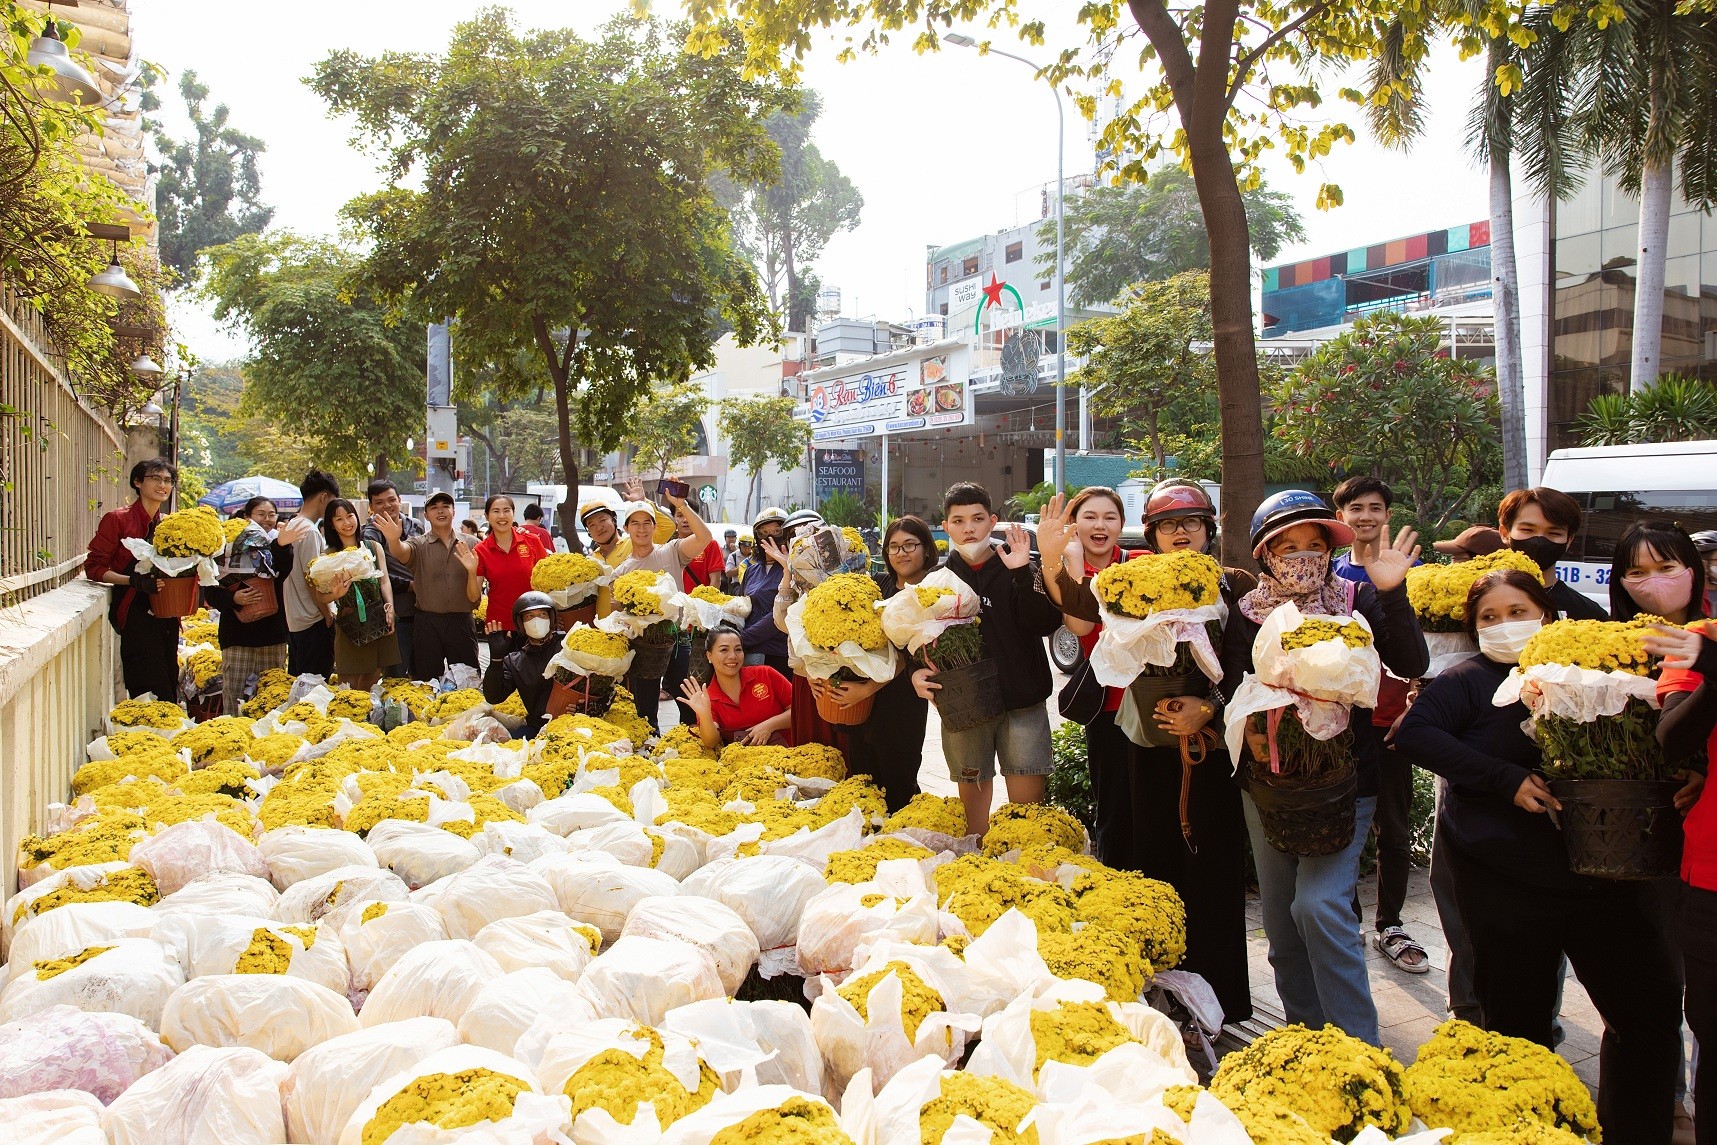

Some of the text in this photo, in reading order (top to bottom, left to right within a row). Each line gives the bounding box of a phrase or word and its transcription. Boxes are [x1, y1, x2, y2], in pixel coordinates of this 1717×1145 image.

[888, 373, 897, 394] 6
[818, 466, 856, 475] SEAFOOD
[1555, 566, 1580, 583] 51B
